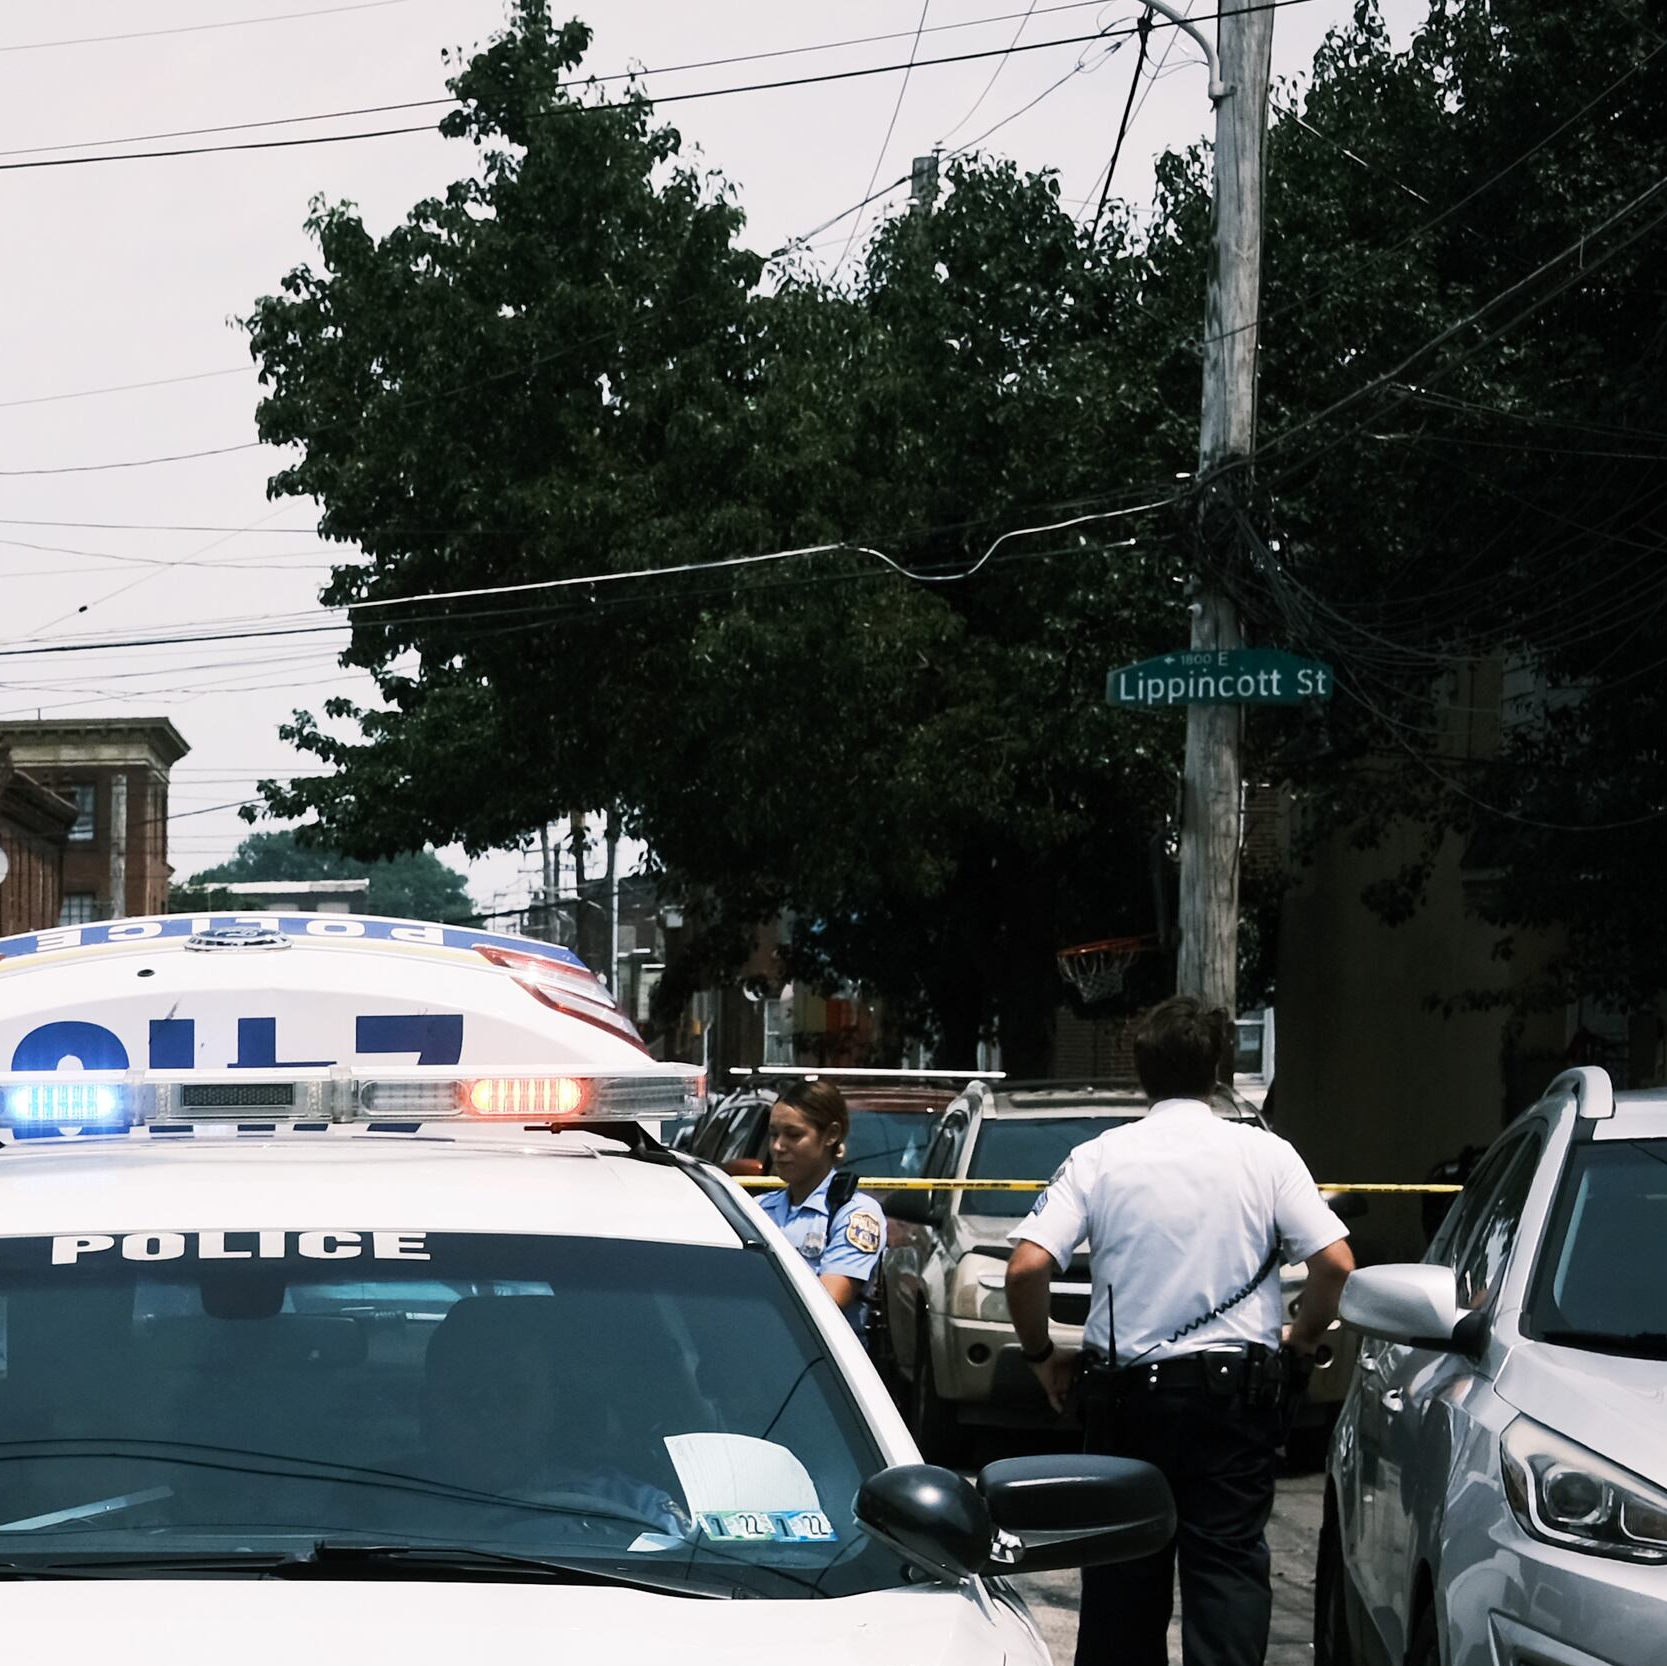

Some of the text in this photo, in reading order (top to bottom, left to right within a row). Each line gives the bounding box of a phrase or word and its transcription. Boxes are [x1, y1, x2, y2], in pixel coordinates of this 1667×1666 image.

[1180, 651, 1229, 667] 1800 E
[1119, 668, 1327, 705] Lippincott St
[36, 917, 446, 948] POLICE
[51, 1230, 431, 1266] POLICE
[739, 1514, 765, 1535] 22
[802, 1515, 828, 1535] 22
